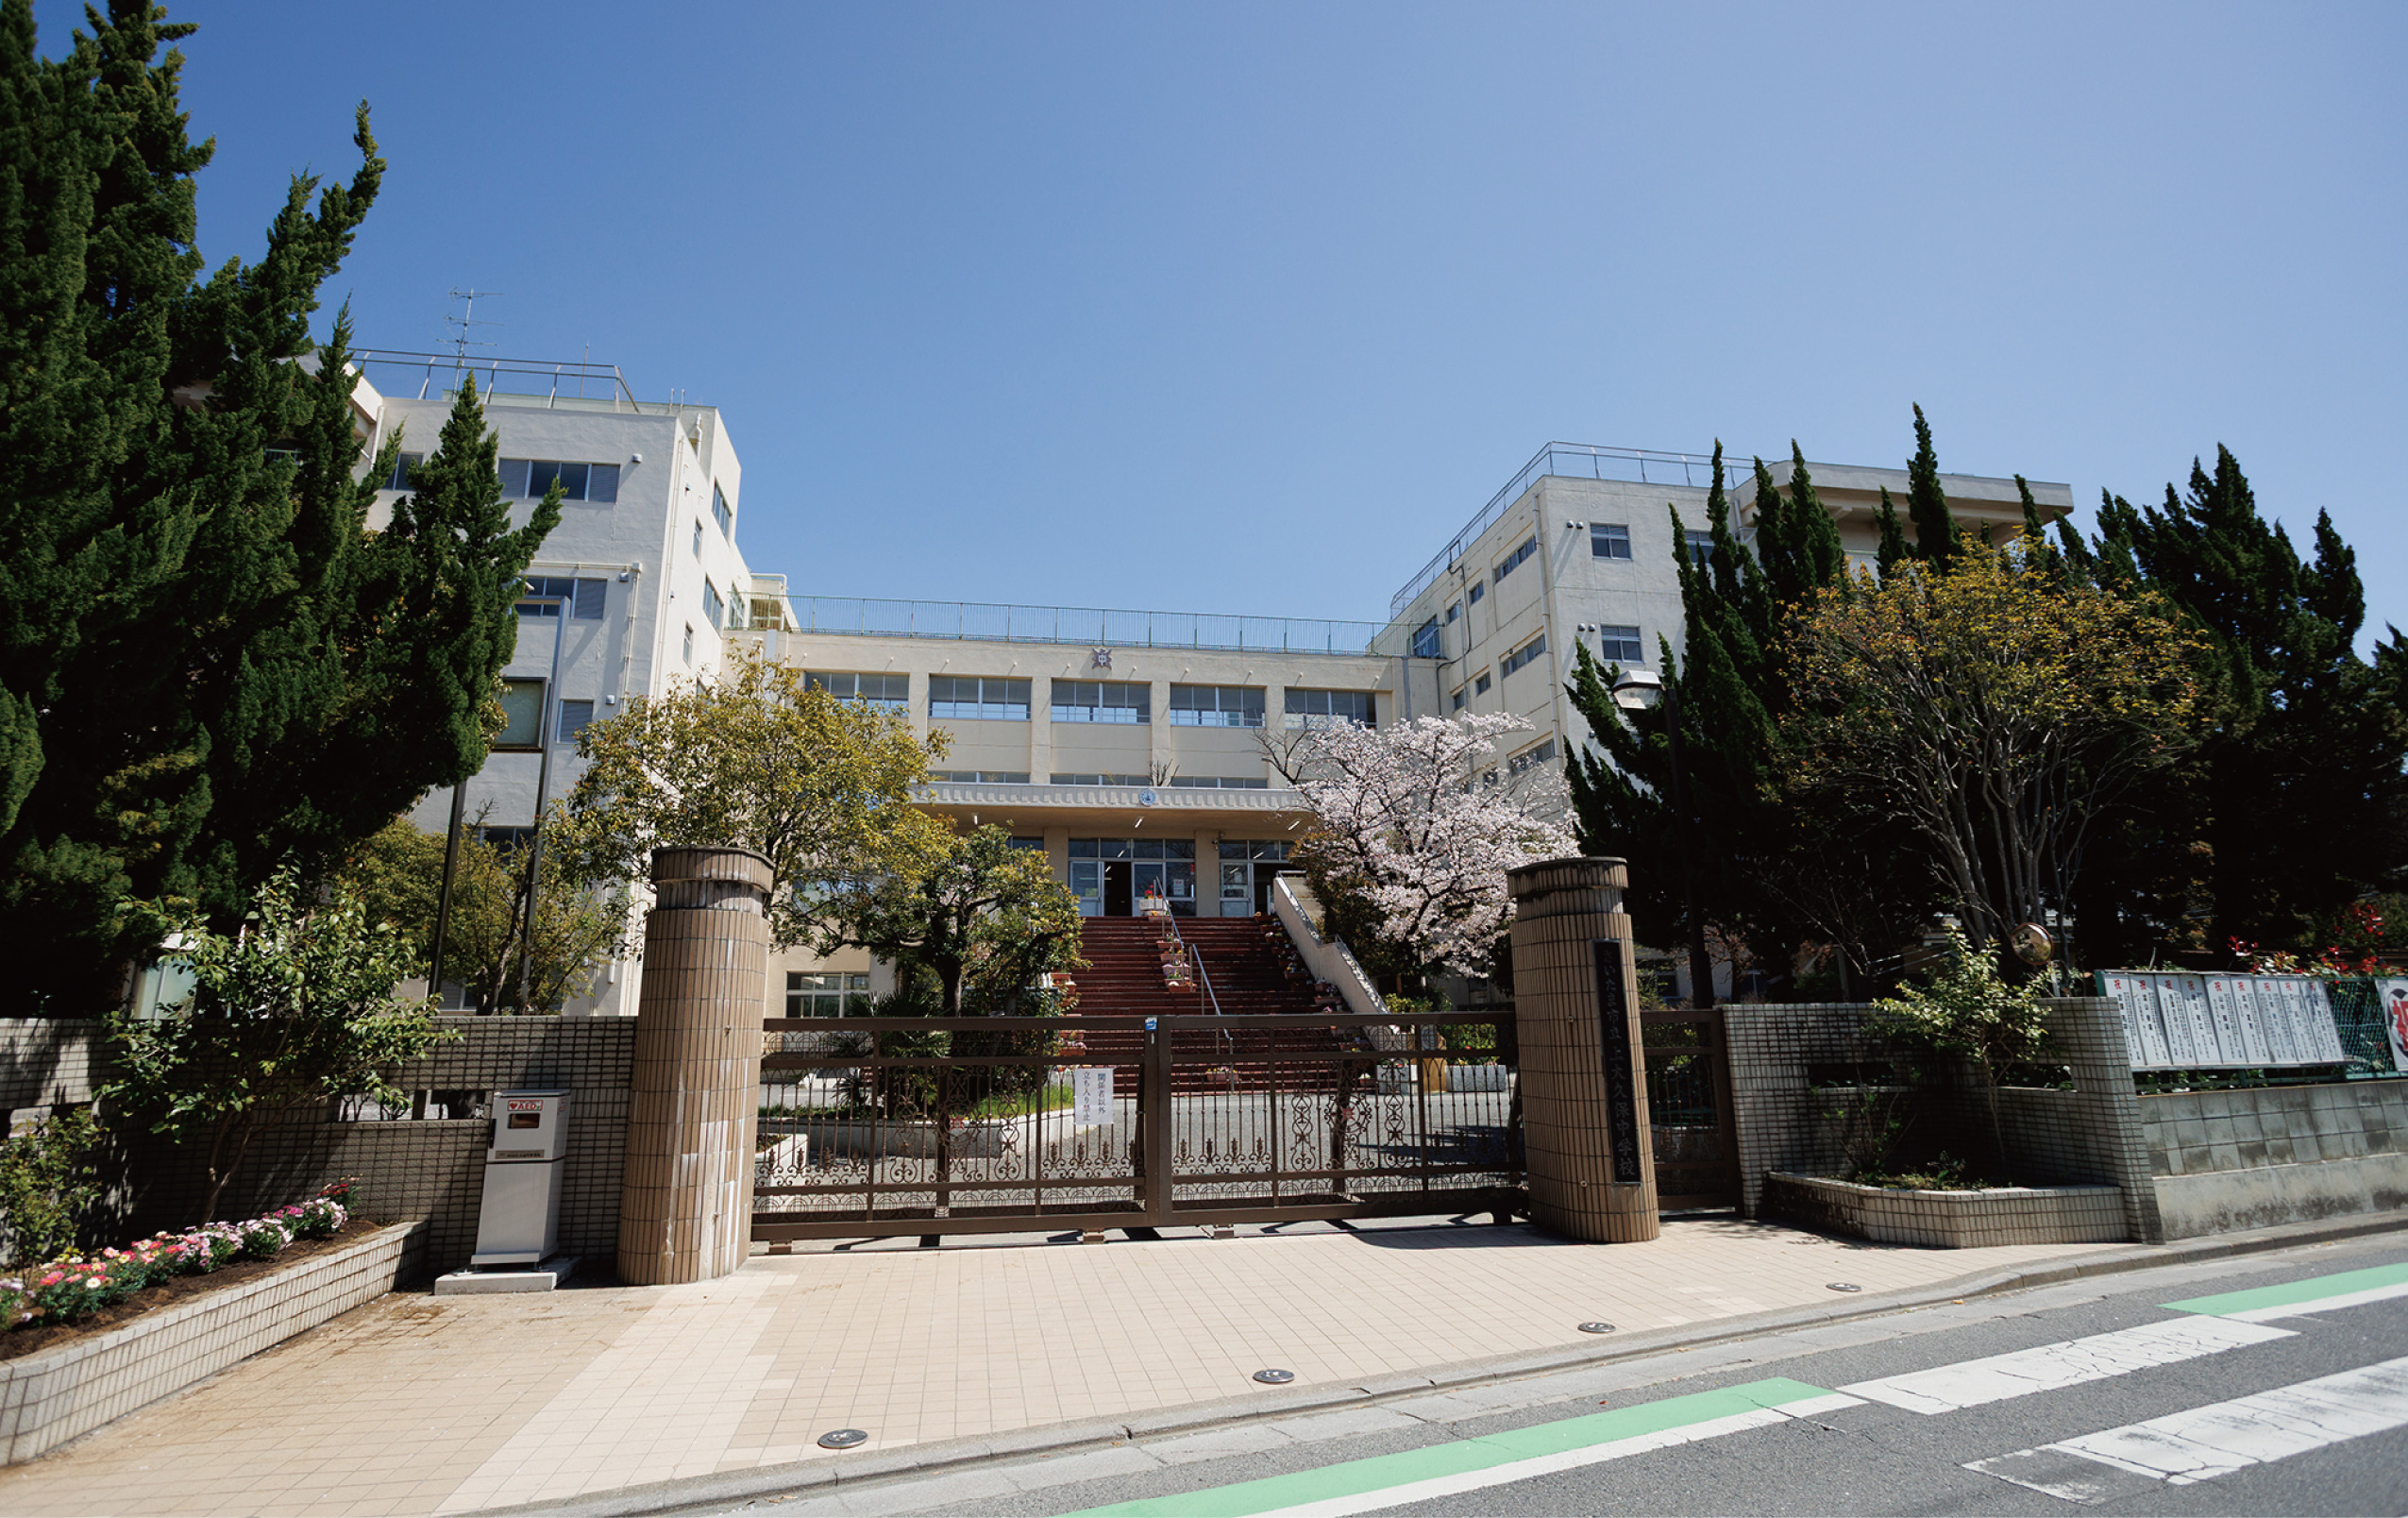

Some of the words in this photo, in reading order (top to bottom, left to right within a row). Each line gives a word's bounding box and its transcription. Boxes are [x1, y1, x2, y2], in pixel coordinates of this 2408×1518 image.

[1083, 1071, 1091, 1121] 立ち入り禁止
[1098, 1072, 1106, 1114] 関係者以外
